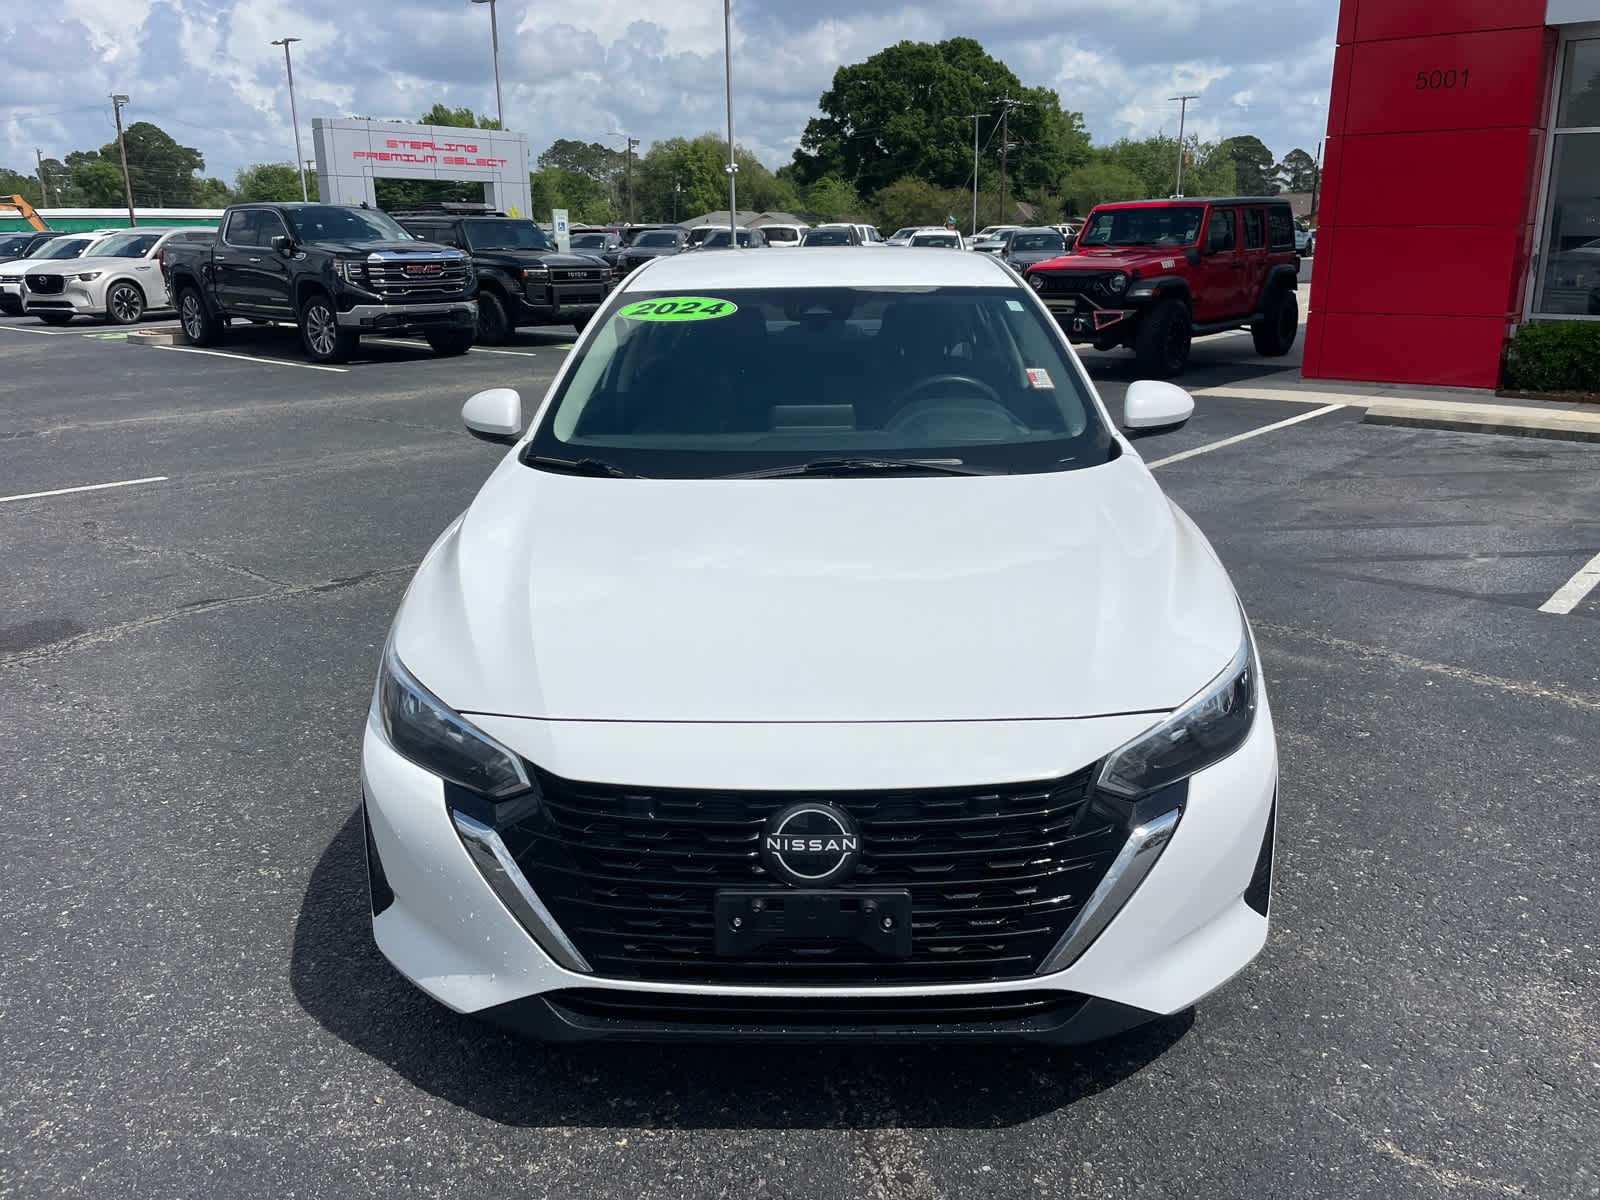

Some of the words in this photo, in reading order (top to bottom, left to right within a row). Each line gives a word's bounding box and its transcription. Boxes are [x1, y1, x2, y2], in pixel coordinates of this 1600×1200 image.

[1416, 68, 1469, 90] 5001
[386, 139, 478, 153] STERLING
[352, 151, 437, 163] PREMIUM
[443, 157, 508, 167] SELECT
[629, 302, 726, 315] 2024
[766, 837, 857, 851] NISSAN
